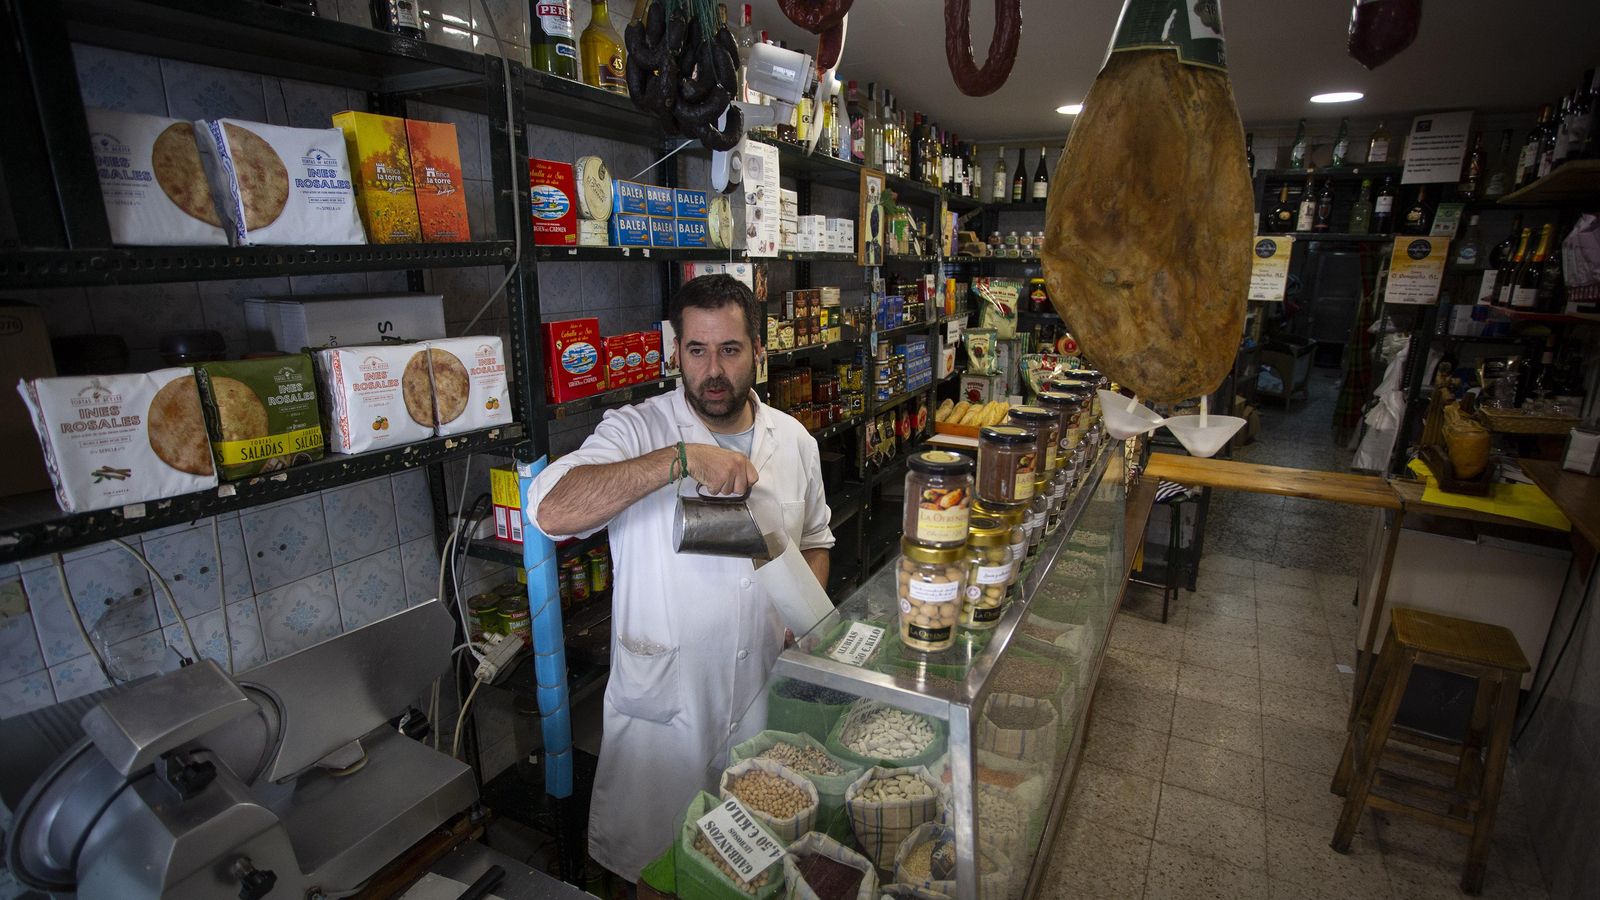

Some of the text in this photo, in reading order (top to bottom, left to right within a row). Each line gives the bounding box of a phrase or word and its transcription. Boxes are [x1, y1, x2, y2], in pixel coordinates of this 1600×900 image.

[612, 58, 623, 69] 43
[96, 156, 130, 168] NES
[98, 168, 152, 182] SALES
[307, 168, 336, 178] INES
[384, 174, 402, 182] torre
[295, 178, 351, 190] ROSALES
[434, 177, 452, 185] torre
[621, 185, 644, 199] BALEA
[647, 190, 672, 203] BALEA
[677, 193, 705, 205] BALEA
[619, 219, 647, 231] BALEA
[652, 221, 673, 233] BALEA
[678, 223, 705, 234] BALEA
[478, 357, 496, 366] INES
[363, 371, 388, 381] INES
[470, 364, 505, 376] ROSALES
[278, 383, 304, 394] INES
[352, 379, 400, 392] ROSALES
[267, 391, 315, 406] ROSALES
[79, 405, 120, 419] INES
[60, 416, 141, 434] ROSALES
[295, 433, 323, 450] SALADA
[241, 441, 284, 461] SALADAS
[727, 827, 754, 855] LECHOSOS
[756, 836, 781, 858] 4,50
[704, 820, 753, 875] GARBANZOS
